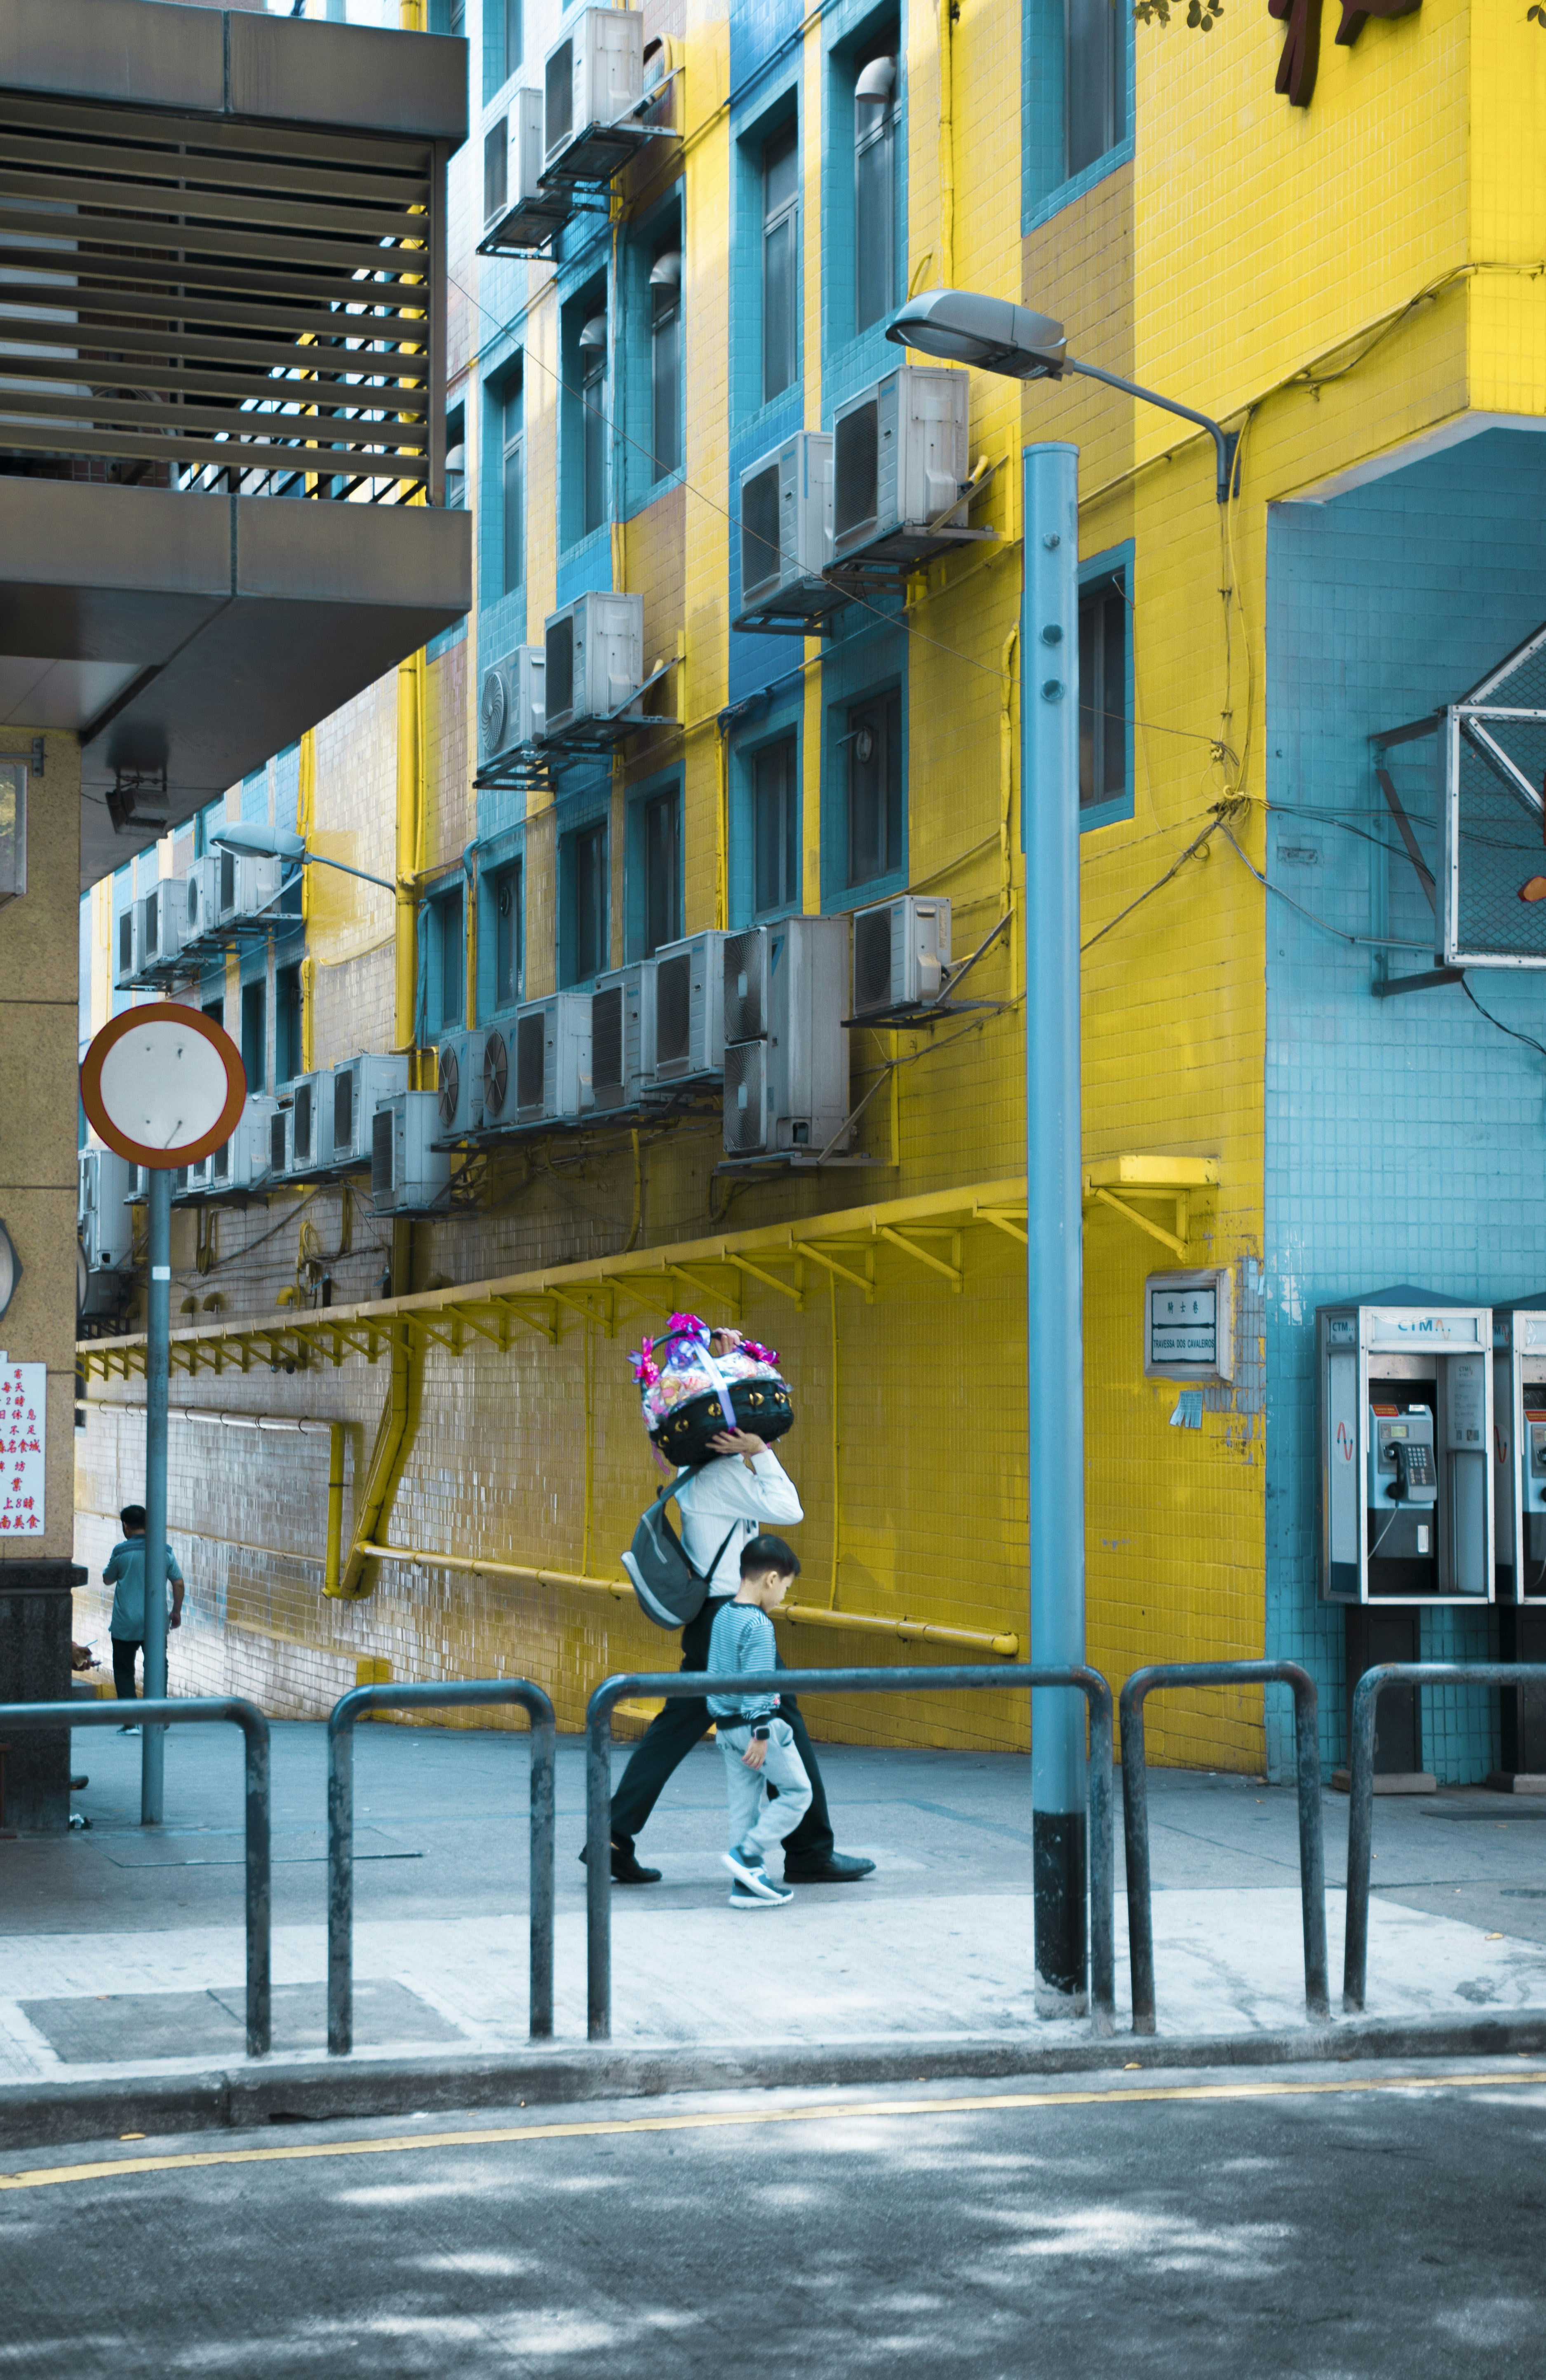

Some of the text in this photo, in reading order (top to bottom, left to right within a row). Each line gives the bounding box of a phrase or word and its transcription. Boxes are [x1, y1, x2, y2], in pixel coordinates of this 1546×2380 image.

[1168, 1300, 1198, 1314] 騎士巷
[1154, 1338, 1215, 1348] TRAVESSA DOS CAVALEIROS
